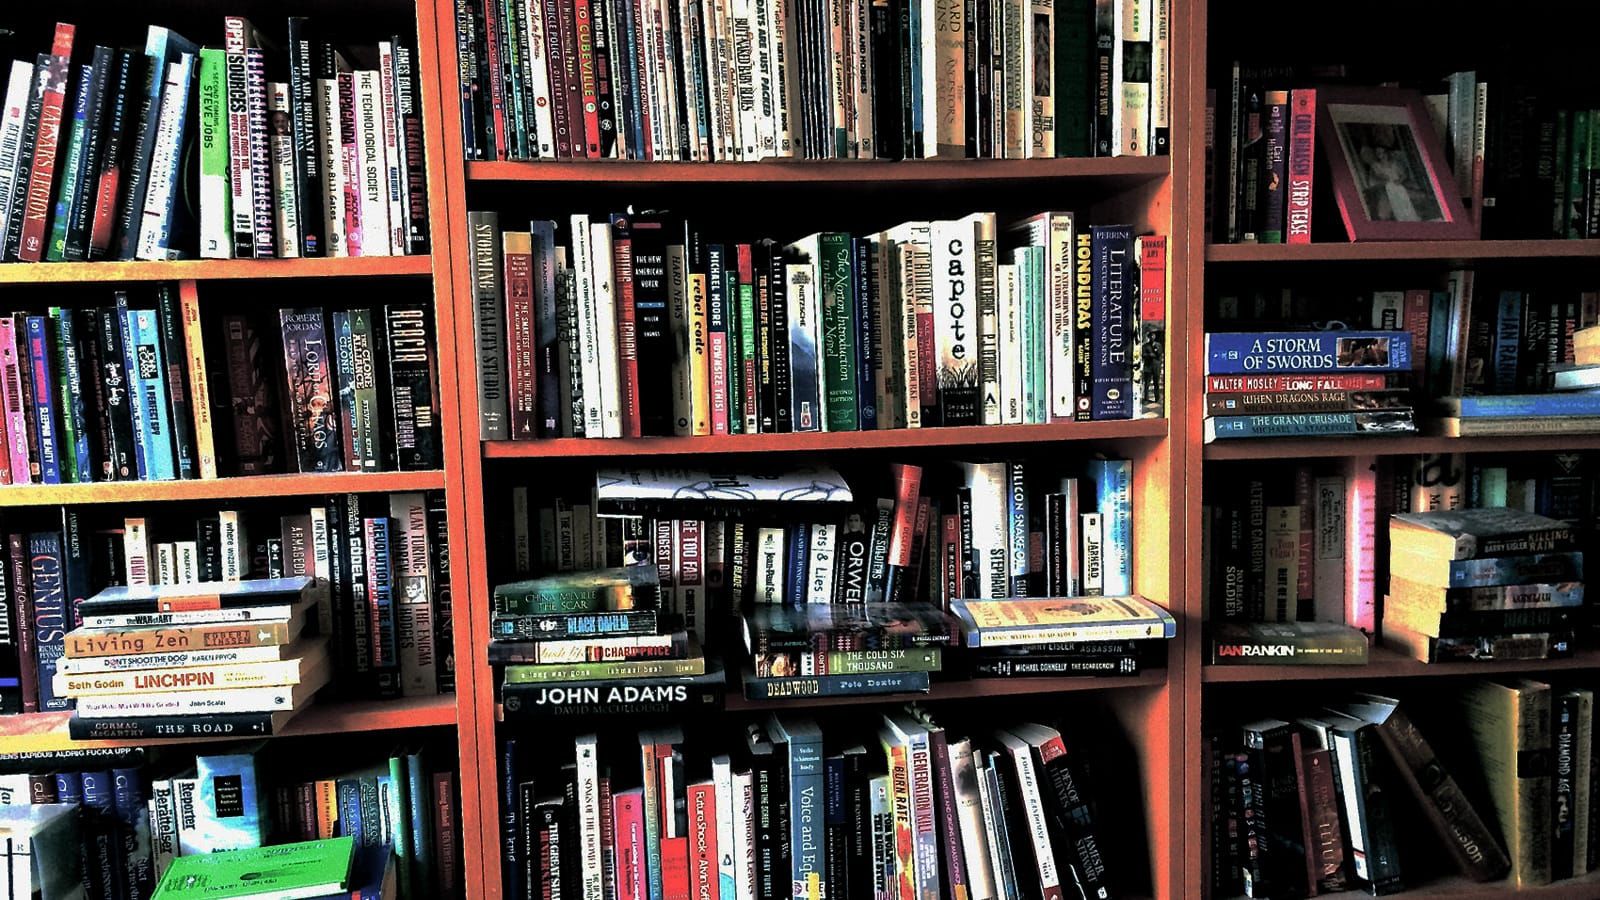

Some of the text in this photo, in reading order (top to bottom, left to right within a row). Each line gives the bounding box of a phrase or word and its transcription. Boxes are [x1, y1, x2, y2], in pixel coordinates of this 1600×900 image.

[227, 19, 246, 112] OPEN SOURCES
[547, 32, 560, 60] POLICE
[580, 6, 594, 96] TO CUBEVILLE
[757, 1, 771, 117] DAYS ARE JUST PACKED
[396, 46, 412, 114] JAMES FALLOWS
[1100, 72, 1108, 97] MAN'S
[204, 85, 213, 149] STEVE JOBS
[324, 86, 334, 136] Barbarians
[338, 75, 355, 145] PROPAGANDA
[1100, 98, 1108, 116] WAR
[1295, 114, 1311, 136] CARL
[326, 139, 334, 154] Led
[361, 72, 377, 202] THE TECHNOLOGICAL SOCIETY
[1274, 146, 1283, 162] Carl
[8, 103, 39, 242] WALTER CRONKITE
[27, 105, 62, 220] CAESAR'S LEGION
[326, 160, 334, 170] by
[328, 172, 336, 192] Bill
[1290, 208, 1308, 235] TEASE
[615, 245, 633, 282] WRITING
[823, 260, 832, 271] to
[976, 240, 994, 260] GIVE
[978, 261, 994, 279] WAR
[672, 256, 683, 319] HARD NEWS
[797, 284, 806, 327] NIETZSCHE
[905, 250, 915, 339] PARLIAMENT of WHORES
[948, 240, 966, 360] capote
[979, 289, 996, 317] CHANCE
[1076, 233, 1091, 330] HONDURAS
[475, 224, 500, 400] STORMING REALITY STUDIO
[692, 279, 704, 355] rebel code
[710, 251, 726, 412] MICHAEL MOORE DOWNSIZE THIS!
[835, 249, 850, 381] The Norton Introduction
[1109, 250, 1126, 365] LITERATURE
[339, 336, 349, 374] CLONE
[390, 310, 427, 363] ACACIA
[619, 322, 636, 361] ECONOMY
[824, 326, 835, 357] Novel
[1250, 339, 1321, 353] A STORM
[353, 334, 364, 389] ALLIANCE
[1212, 377, 1278, 391] WALTER MOSLEY
[1244, 354, 1333, 369] OF SWORDS
[6, 364, 20, 412] VALEDICTION
[1243, 391, 1345, 405] WHEN DRAGONS RAGE
[1251, 414, 1352, 428] THE GRAND CRUSADE
[962, 518, 971, 554] STEWART
[1012, 464, 1025, 569] SILICON SNAKE OIL
[1250, 481, 1264, 573] ALTERED CARBON
[226, 523, 236, 576] where wizards
[657, 521, 672, 582] LONGEST DAY
[682, 537, 698, 581] TOO FAR
[733, 523, 744, 588] MAKING OF BLADE
[1090, 541, 1099, 578] JARHEAD
[1529, 540, 1555, 552] RAIN
[30, 555, 65, 643] GENIUS
[373, 523, 392, 662] REVOLUTION IN THE VALLEY
[410, 505, 431, 666] ALAN TURING: THE ENIGMA
[538, 599, 588, 611] THE SCAR
[1225, 566, 1235, 617] SOLDIER
[74, 633, 189, 654] Living Zen
[568, 615, 629, 633] BLACK DAHLIA
[846, 649, 905, 661] THE COLD SIX
[846, 660, 894, 671] THOUSAND
[1218, 645, 1294, 657] IAN RANKIN
[68, 672, 214, 690] Seth Godin LINCHPIN
[536, 685, 688, 706] JOHN ADAMS
[767, 679, 819, 697] DEADWOOD
[155, 723, 234, 734] THE ROAD
[1020, 756, 1032, 787] FOOLED
[1557, 734, 1570, 793] DIAMOND AGE
[181, 782, 196, 830] Reporter
[895, 766, 907, 822] BURN RATE
[912, 752, 931, 835] GENERATION KILL
[156, 789, 173, 854] Berättelser
[801, 786, 815, 851] Voice and
[549, 823, 560, 877] THE GREAT
[1318, 823, 1335, 875] ILIUM
